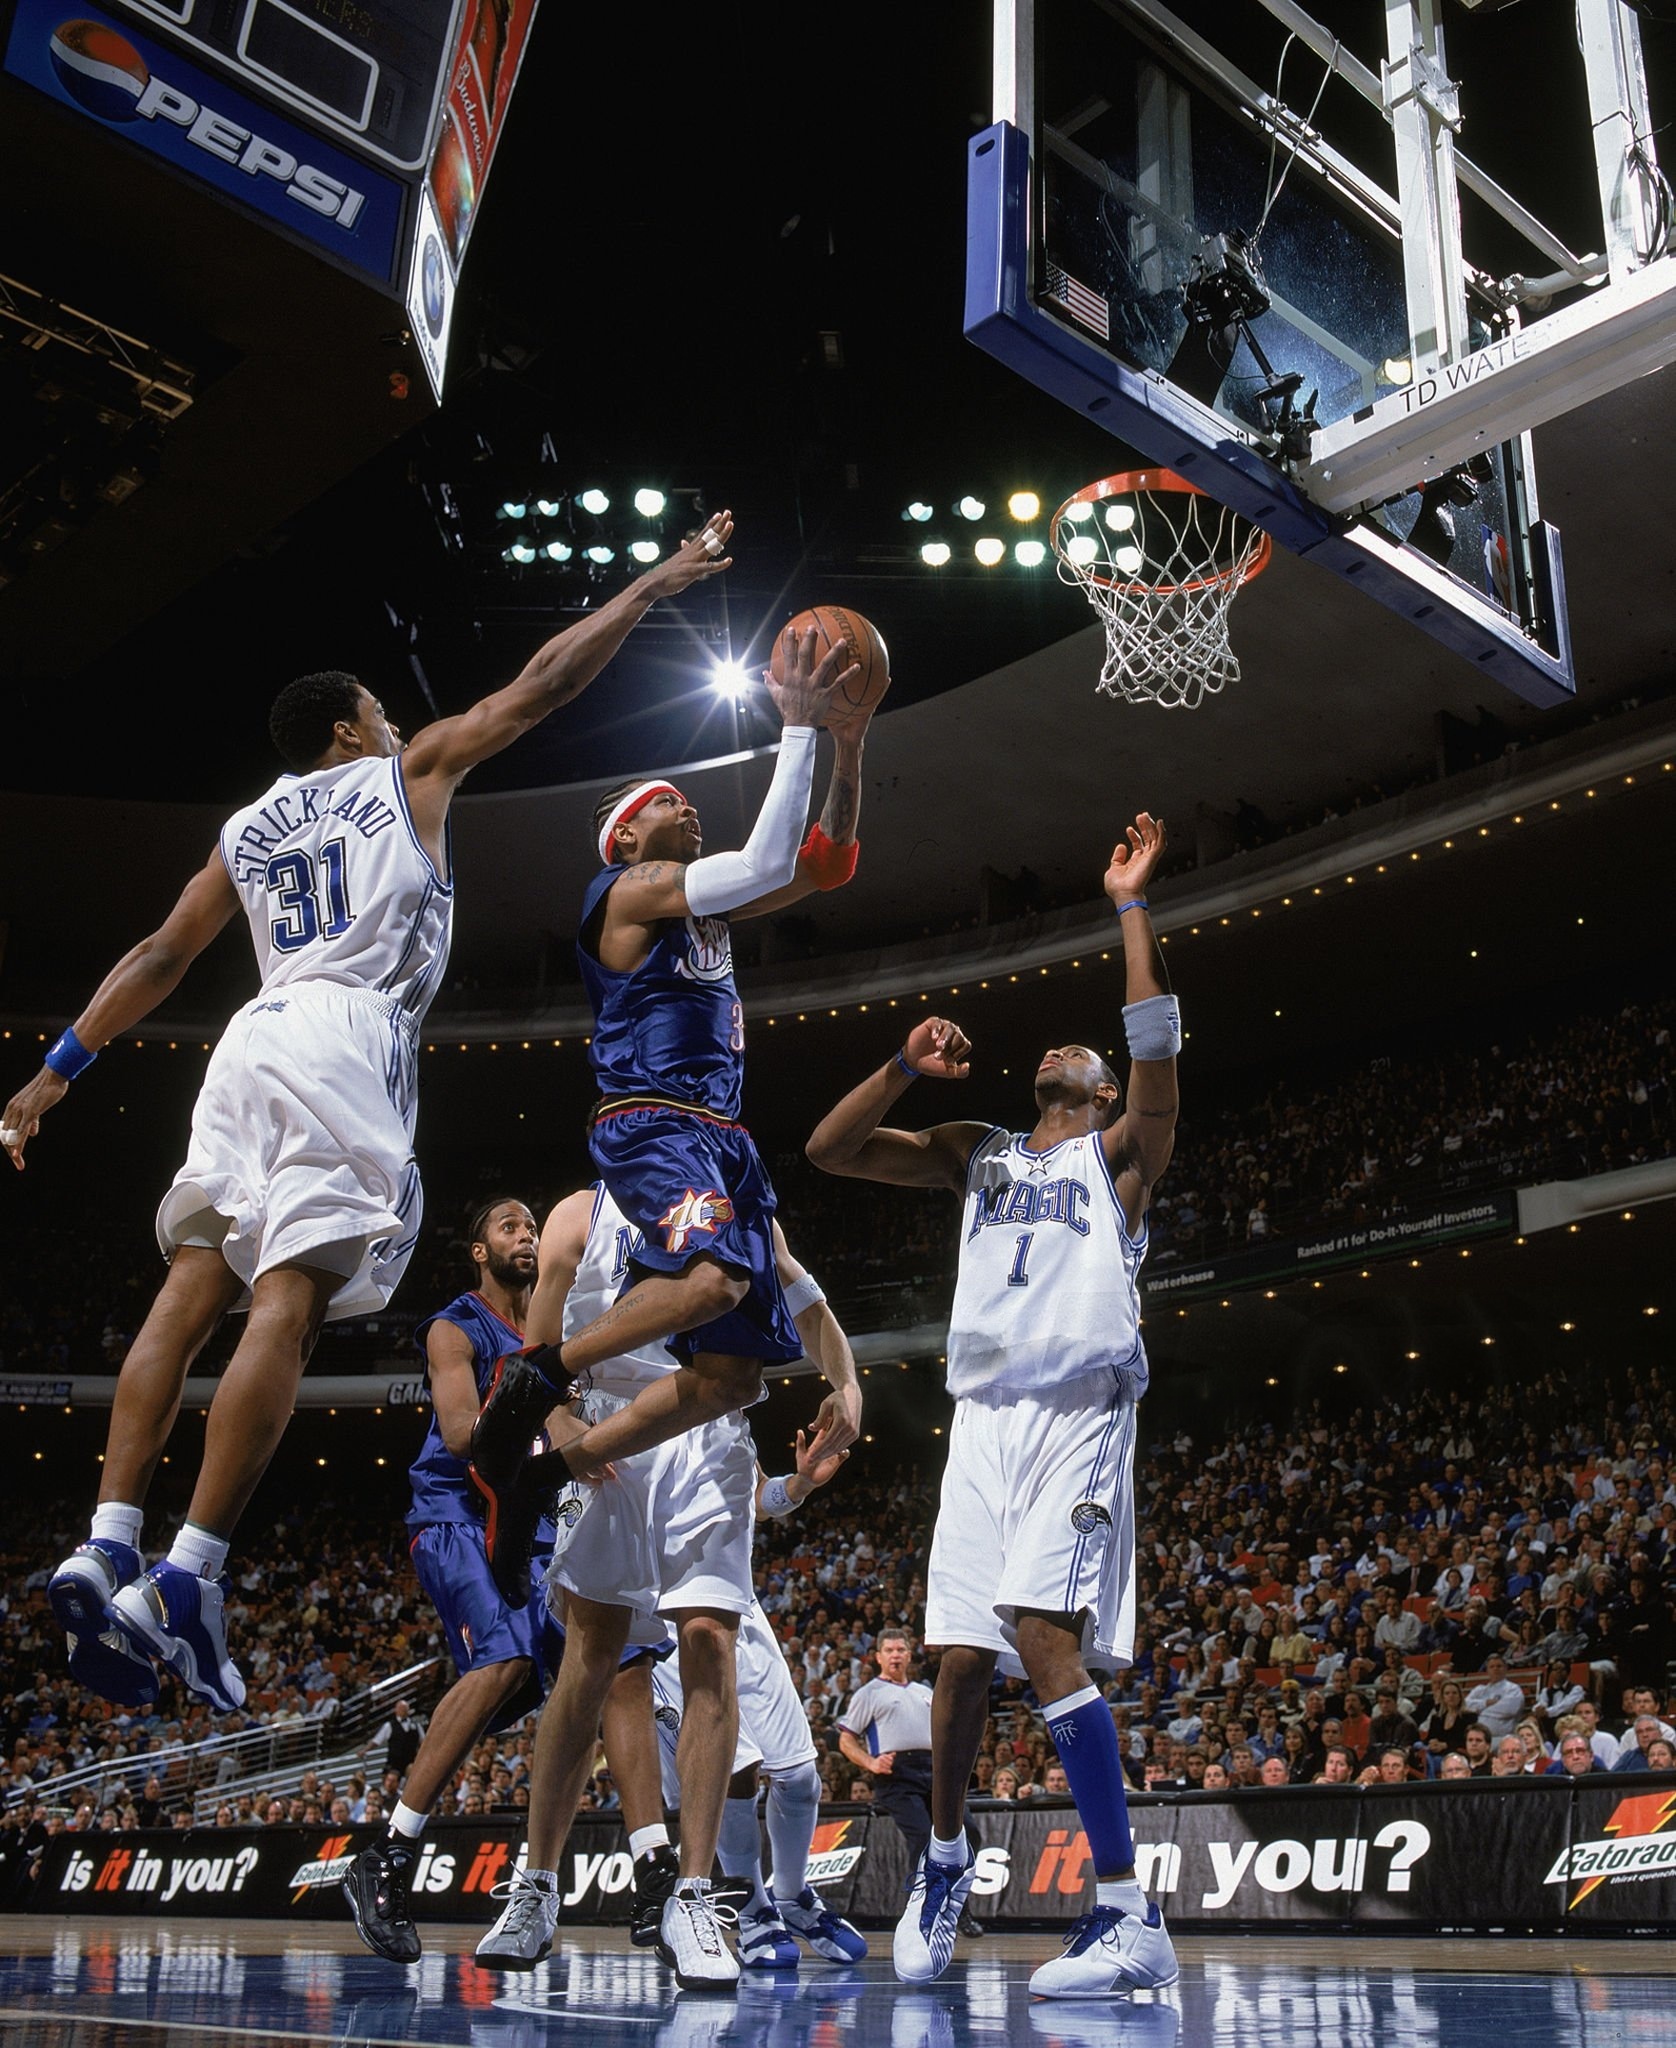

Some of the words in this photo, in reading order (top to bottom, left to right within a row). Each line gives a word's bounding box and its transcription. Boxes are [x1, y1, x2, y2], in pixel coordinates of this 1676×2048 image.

[135, 75, 365, 228] PEPSI
[1399, 380, 1437, 412] TD
[1446, 329, 1538, 390] WATE
[235, 788, 397, 885] STRICKLAND
[264, 837, 357, 954] 31
[730, 1003, 746, 1051] 3
[967, 1178, 1091, 1244] MAGIC
[1296, 1239, 1335, 1259] Ranked
[1335, 1235, 1350, 1250] #1
[1351, 1231, 1367, 1247] for
[1444, 1204, 1497, 1225] Investors.
[1008, 1232, 1034, 1287] 1
[1146, 1269, 1216, 1292] Waterhouse
[60, 1850, 94, 1891] is
[94, 1849, 131, 1891] it
[126, 1849, 163, 1891] in
[160, 1847, 259, 1902] you?
[412, 1843, 456, 1893] is
[462, 1842, 508, 1893] it
[508, 1843, 529, 1893] i
[563, 1852, 637, 1906] yo
[970, 1847, 1011, 1895] s
[1029, 1829, 1093, 1895] it
[1130, 1828, 1182, 1893] n
[1202, 1820, 1431, 1909] you?
[1557, 1841, 1676, 1876] Gatorad
[1609, 1873, 1639, 1885] thirst
